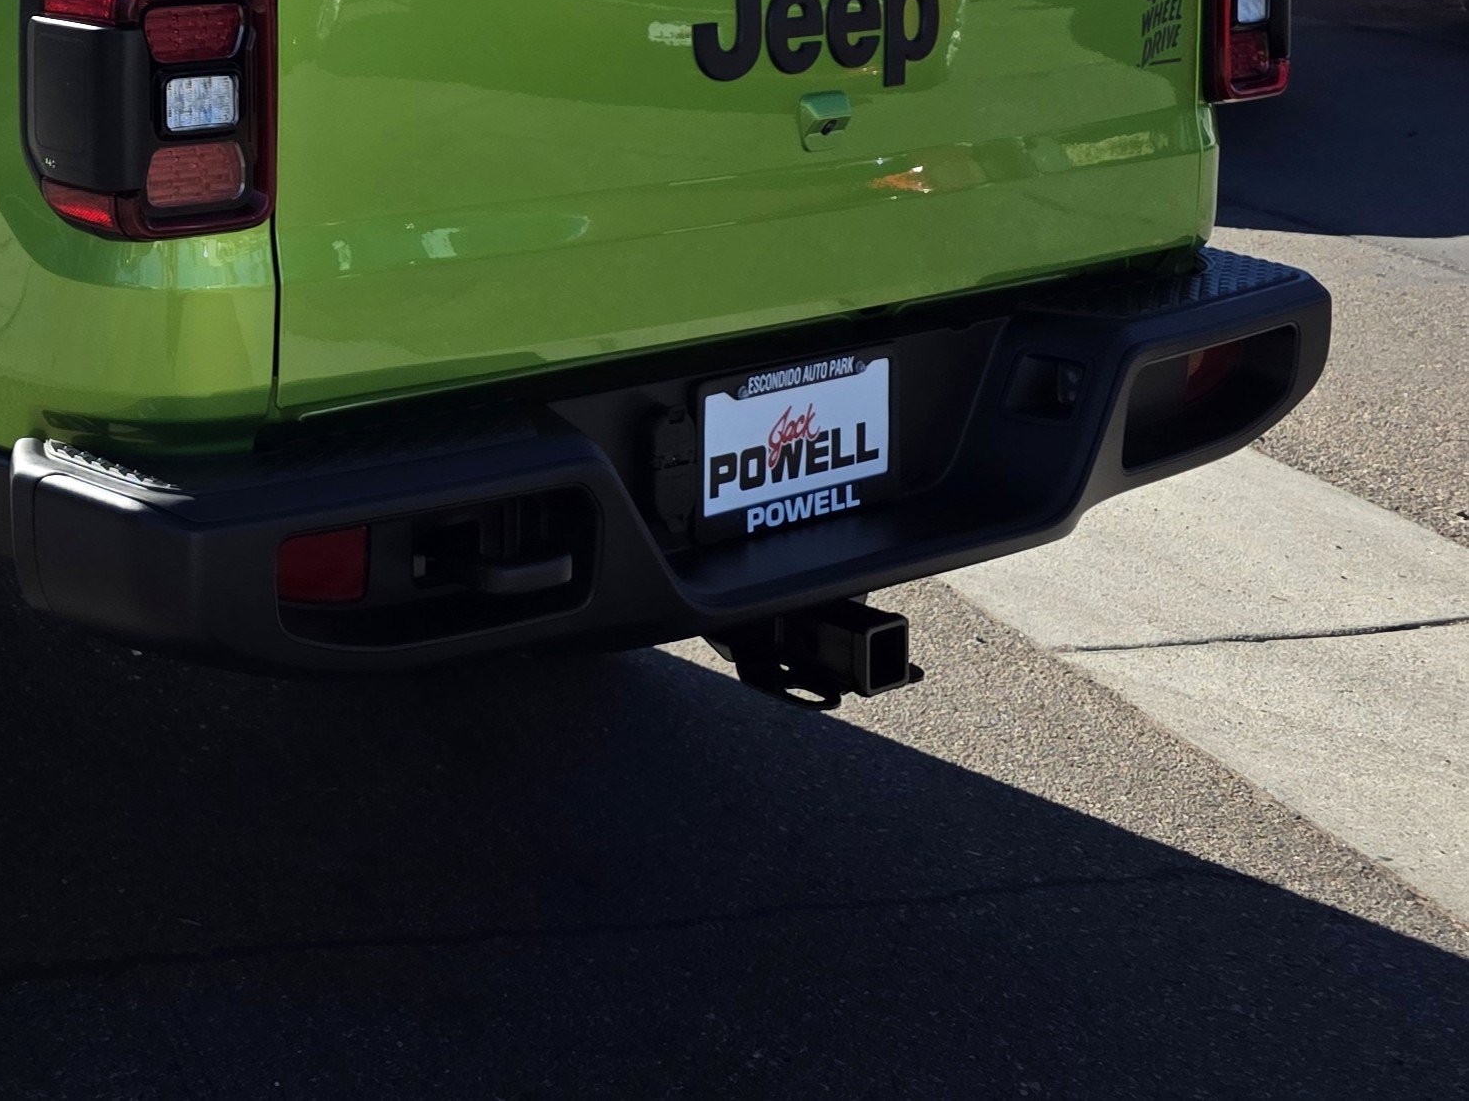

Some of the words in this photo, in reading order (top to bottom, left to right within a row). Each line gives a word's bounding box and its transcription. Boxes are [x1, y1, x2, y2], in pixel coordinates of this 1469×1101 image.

[1140, 24, 1181, 69] DRIVE
[748, 366, 802, 395] ESCONDIDO
[802, 361, 829, 383] AUTO
[829, 355, 855, 378] PARK
[768, 402, 821, 468] Jack
[709, 421, 880, 499] POWELL
[746, 484, 861, 533] POWELL
